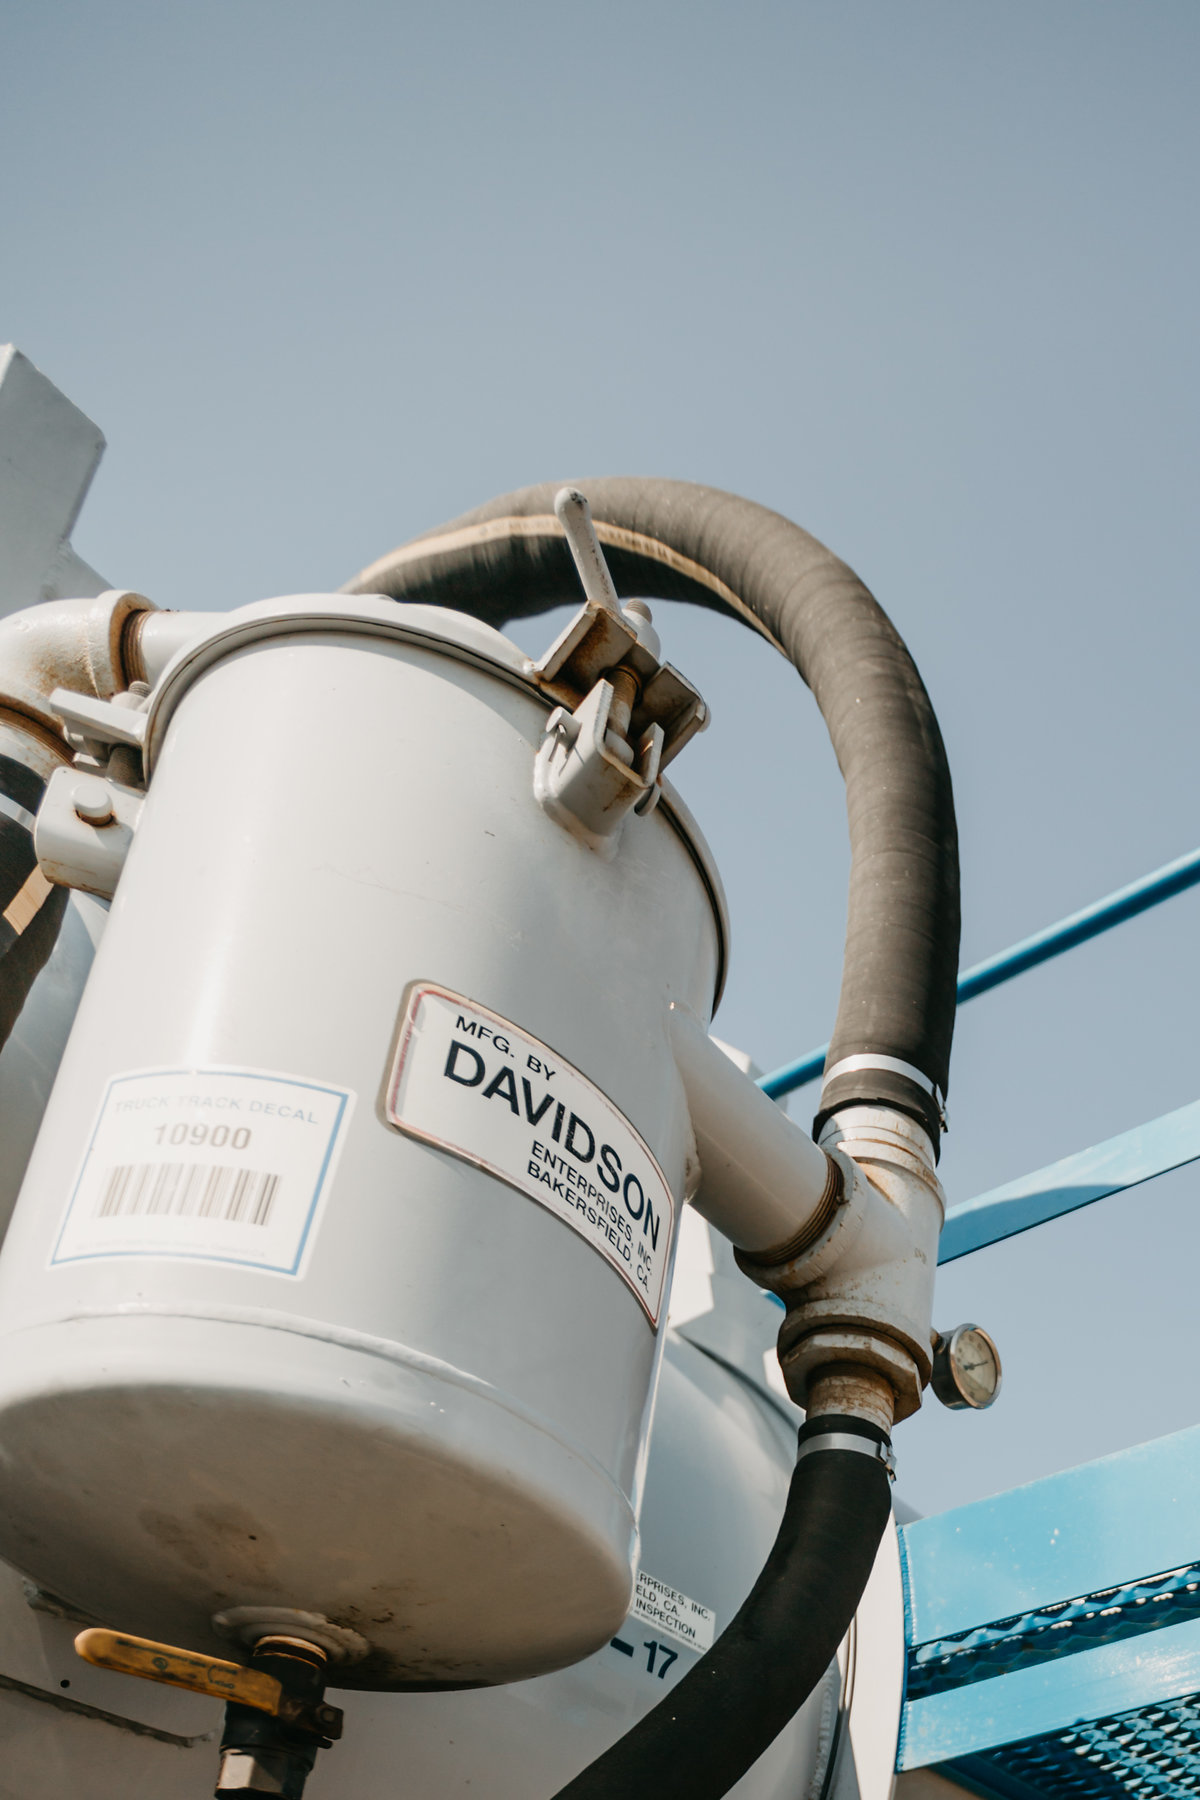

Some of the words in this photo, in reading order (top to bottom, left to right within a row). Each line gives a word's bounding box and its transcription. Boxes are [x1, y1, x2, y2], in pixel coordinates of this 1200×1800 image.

[455, 1015, 515, 1058] MFG.
[525, 1054, 556, 1081] BY
[114, 1096, 169, 1114] TRUCK
[177, 1095, 242, 1111] TRACK
[248, 1100, 319, 1125] DECAL
[153, 1123, 252, 1150] 10900
[444, 1039, 660, 1252] DAVIDSON
[527, 1160, 633, 1269] BAKERSFIELD,
[531, 1140, 634, 1248] ENTERPRISES,
[635, 1584, 659, 1607] ELD,
[663, 1600, 681, 1617] CA.
[635, 1598, 696, 1639] INSPECTION
[639, 1572, 687, 1609] RPRISES,
[691, 1602, 711, 1622] INC.
